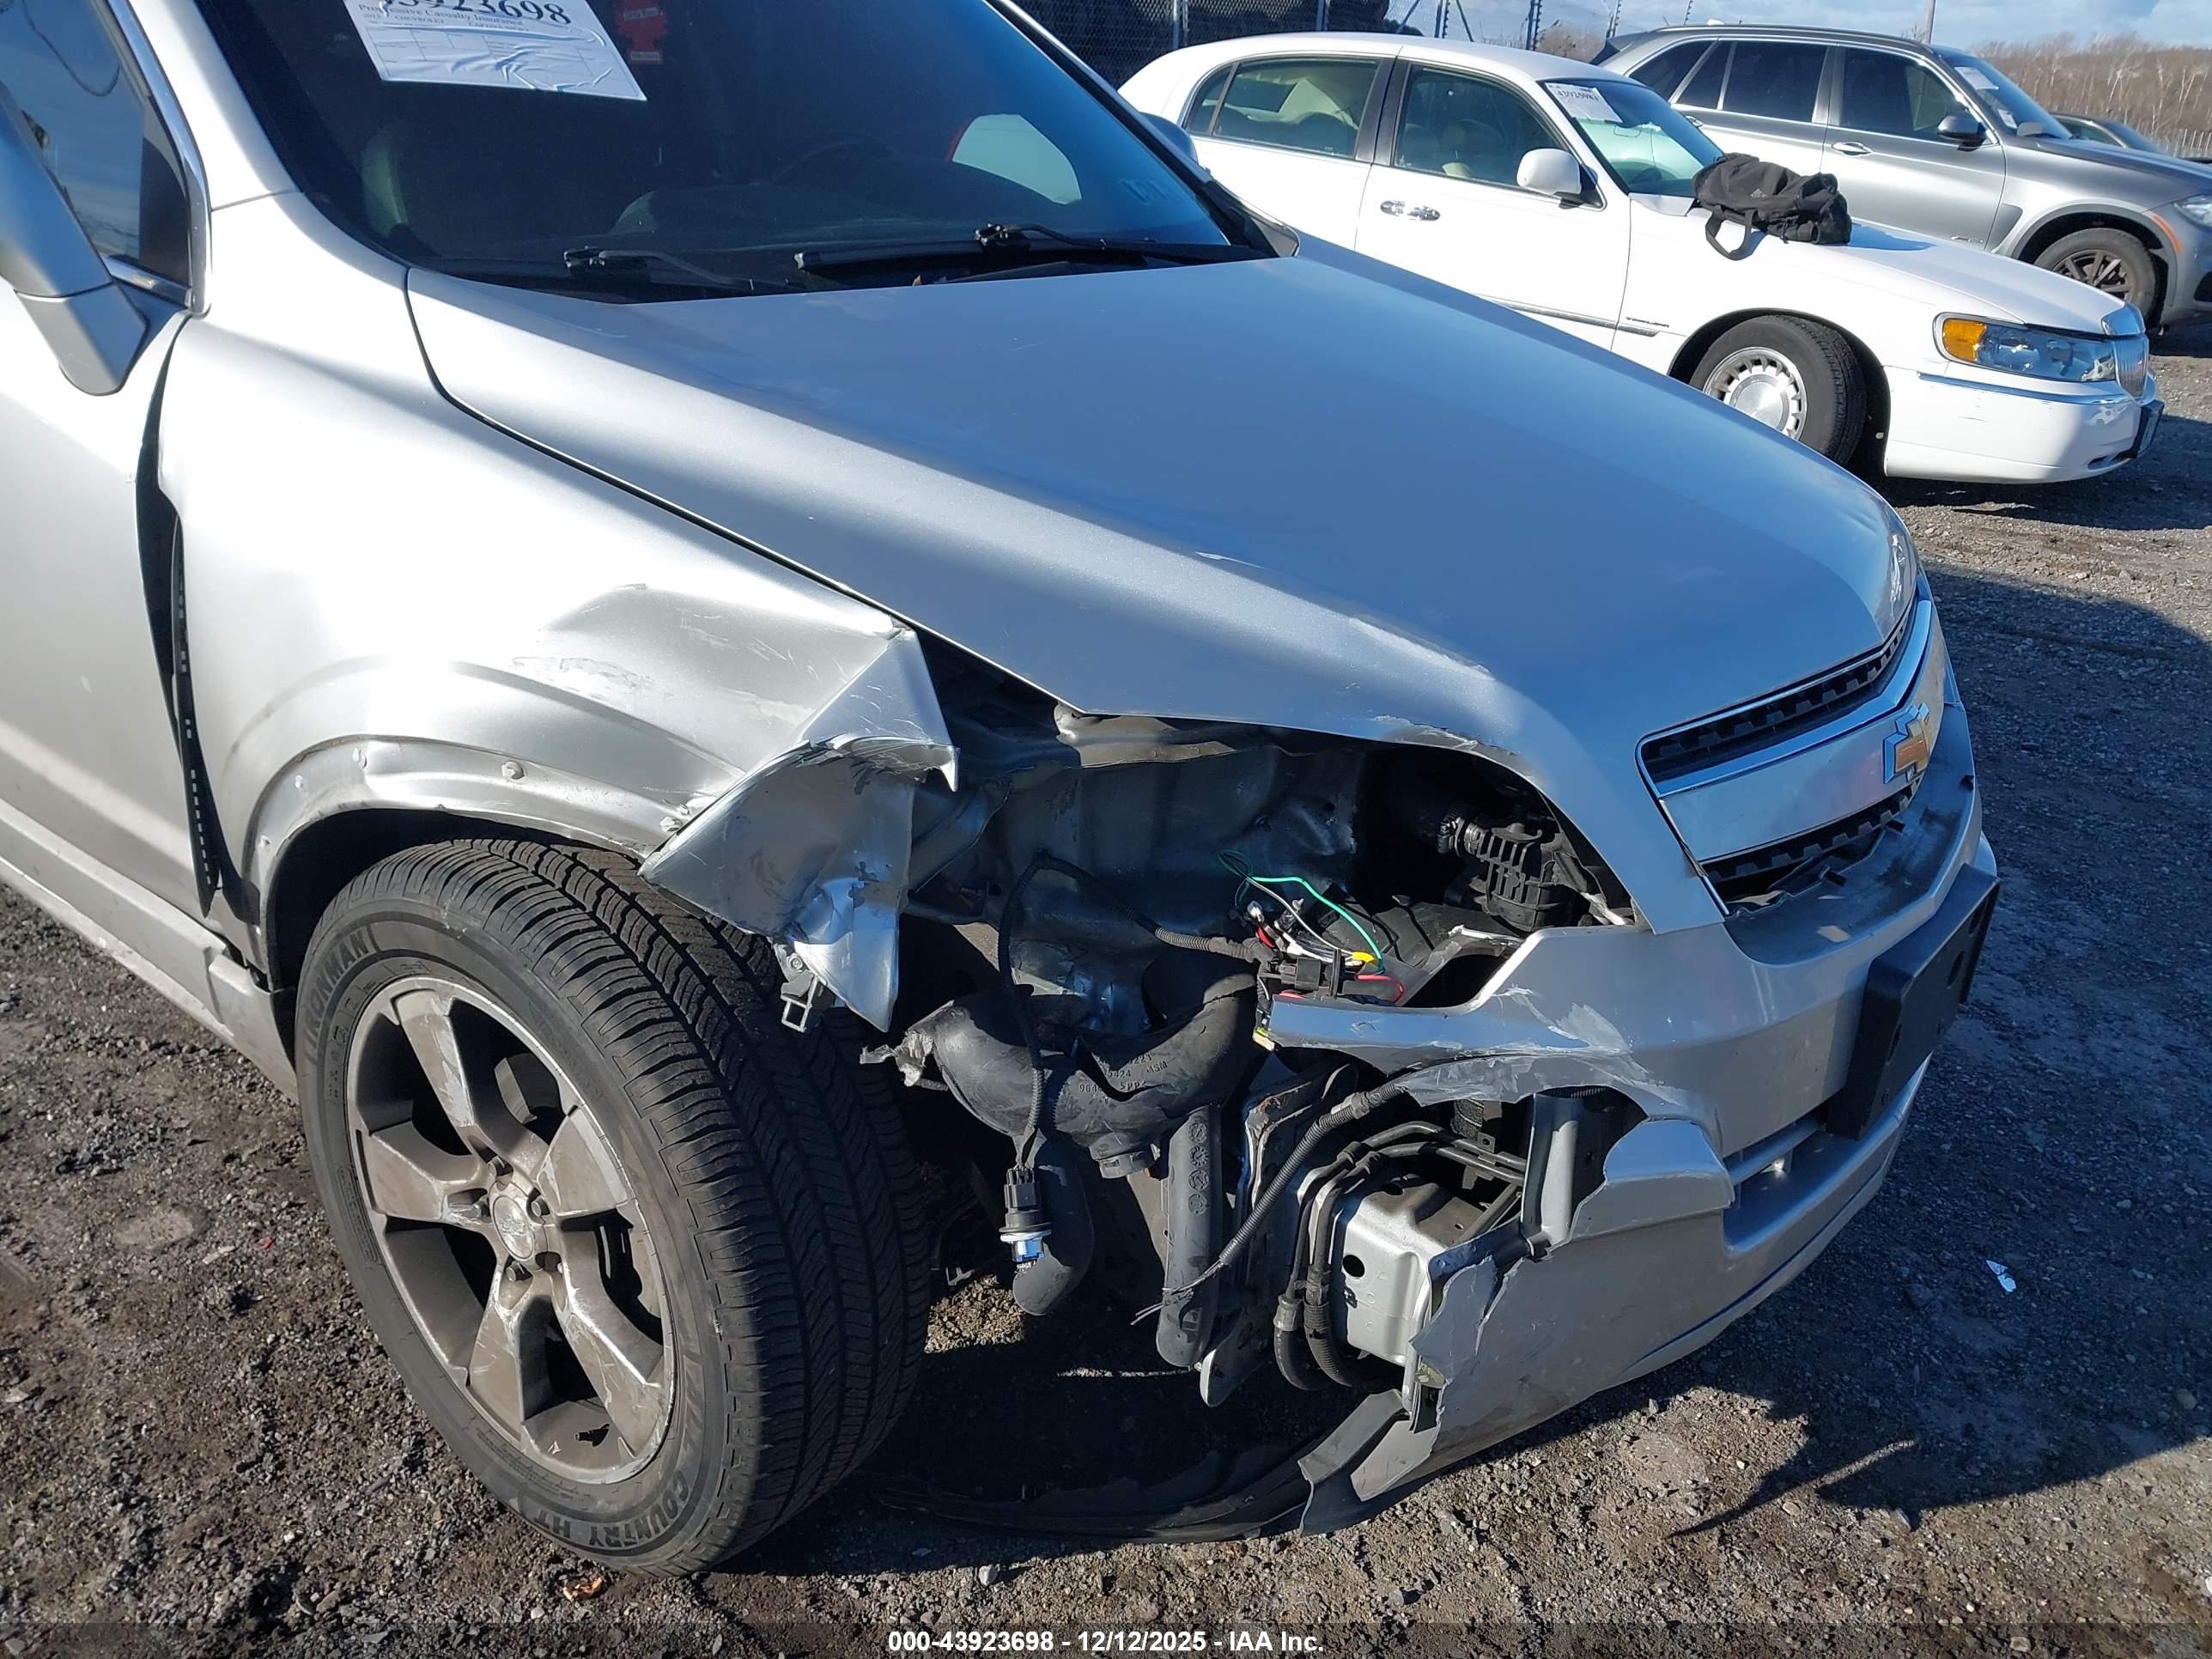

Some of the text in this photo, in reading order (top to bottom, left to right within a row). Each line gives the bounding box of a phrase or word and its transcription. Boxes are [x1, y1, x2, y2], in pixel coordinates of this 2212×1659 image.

[358, 3, 422, 14] Progessive
[384, 0, 571, 24] 23698
[304, 929, 370, 1047] IRONMAN
[1146, 1060, 1169, 1073] ASM
[535, 1469, 689, 1547] COUNTRY HT
